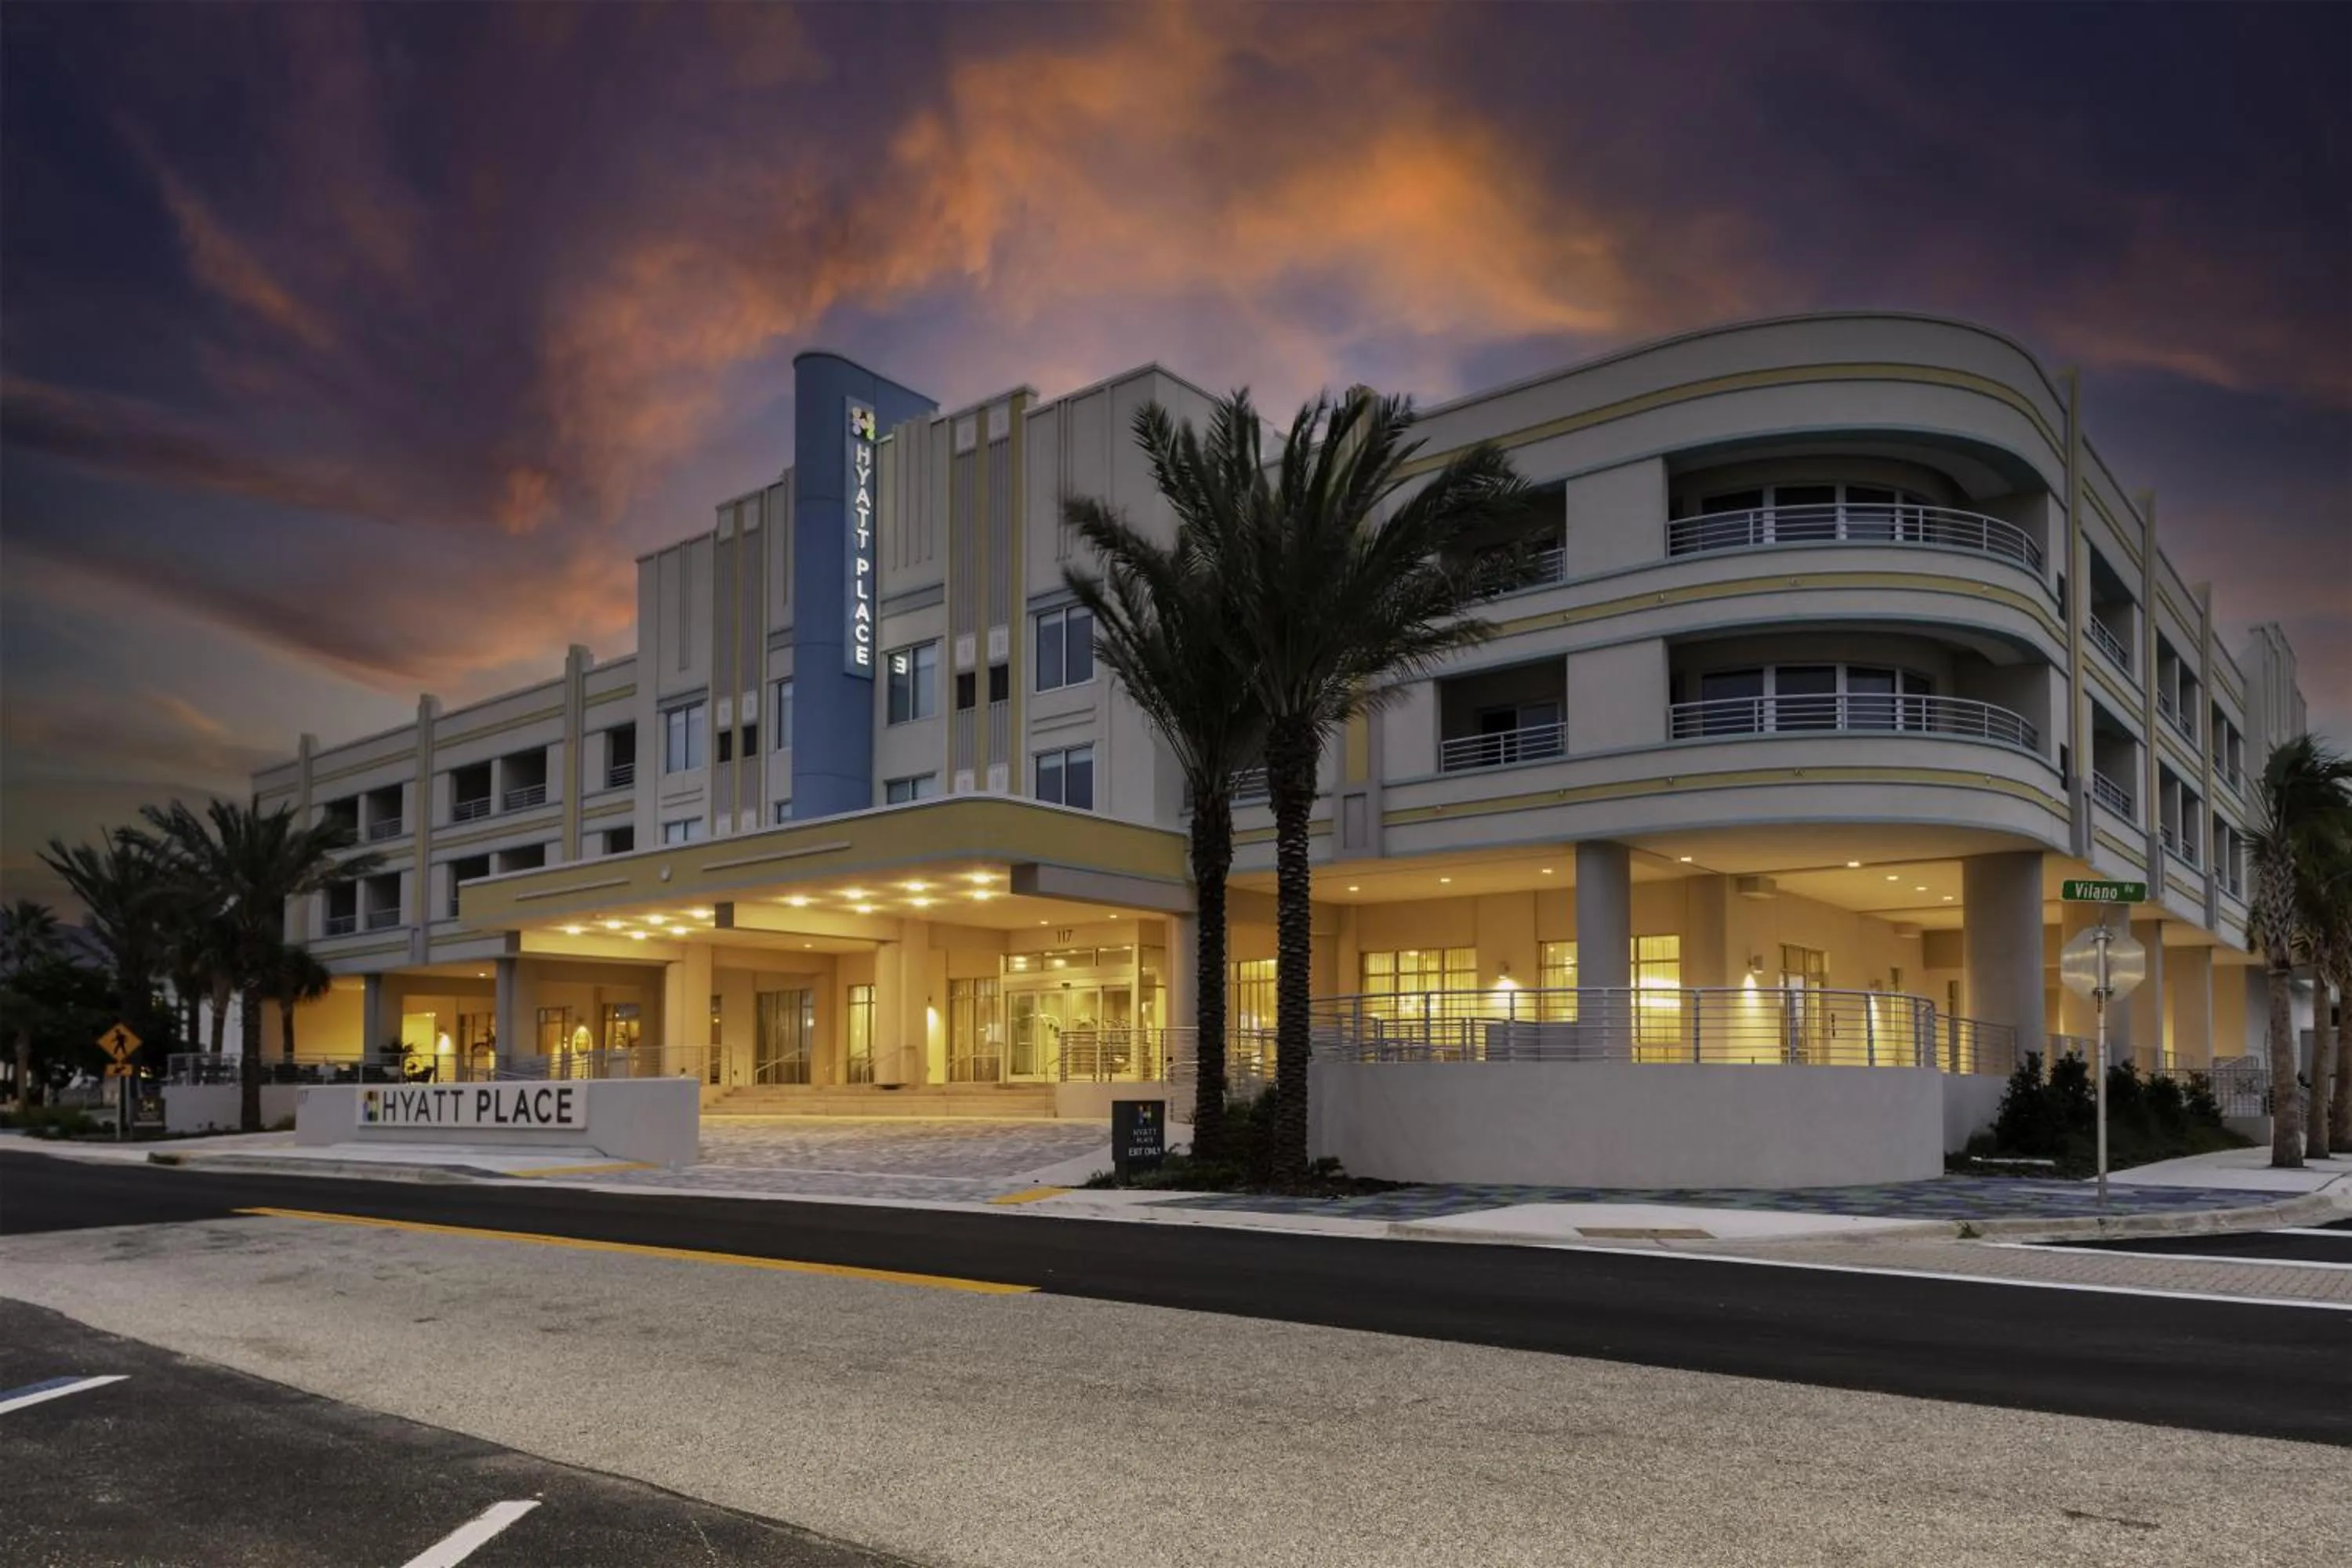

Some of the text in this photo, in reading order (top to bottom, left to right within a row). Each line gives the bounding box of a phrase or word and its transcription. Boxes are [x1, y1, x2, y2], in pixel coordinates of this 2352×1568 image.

[855, 444, 870, 666] HYATT PLACE
[2075, 883, 2118, 899] Vilano
[1057, 929, 1073, 944] 117
[383, 1088, 573, 1123] HYATT PLACE
[1129, 1147, 1142, 1156] EXIT
